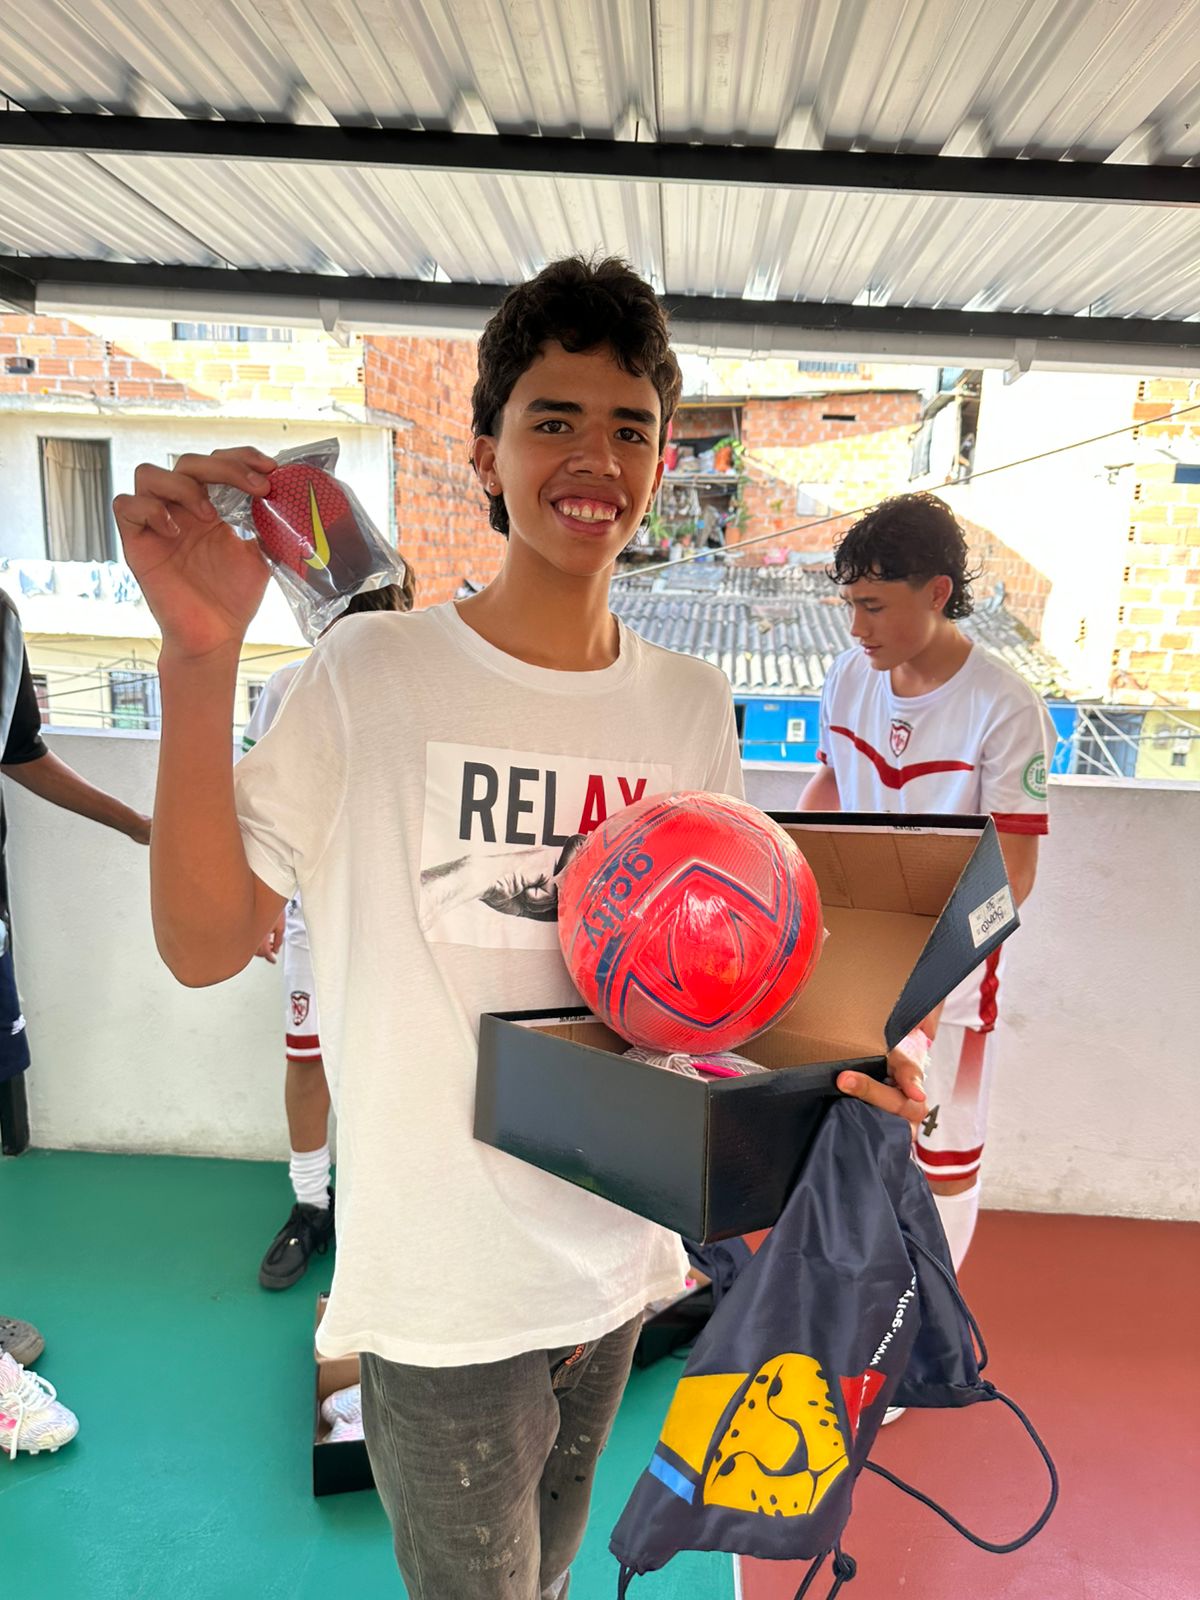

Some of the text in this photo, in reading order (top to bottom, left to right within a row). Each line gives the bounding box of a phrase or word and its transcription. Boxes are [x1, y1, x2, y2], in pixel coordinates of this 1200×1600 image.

[582, 847, 654, 950] golty
[921, 1104, 940, 1137] 4
[869, 1274, 917, 1366] www.golty.c
